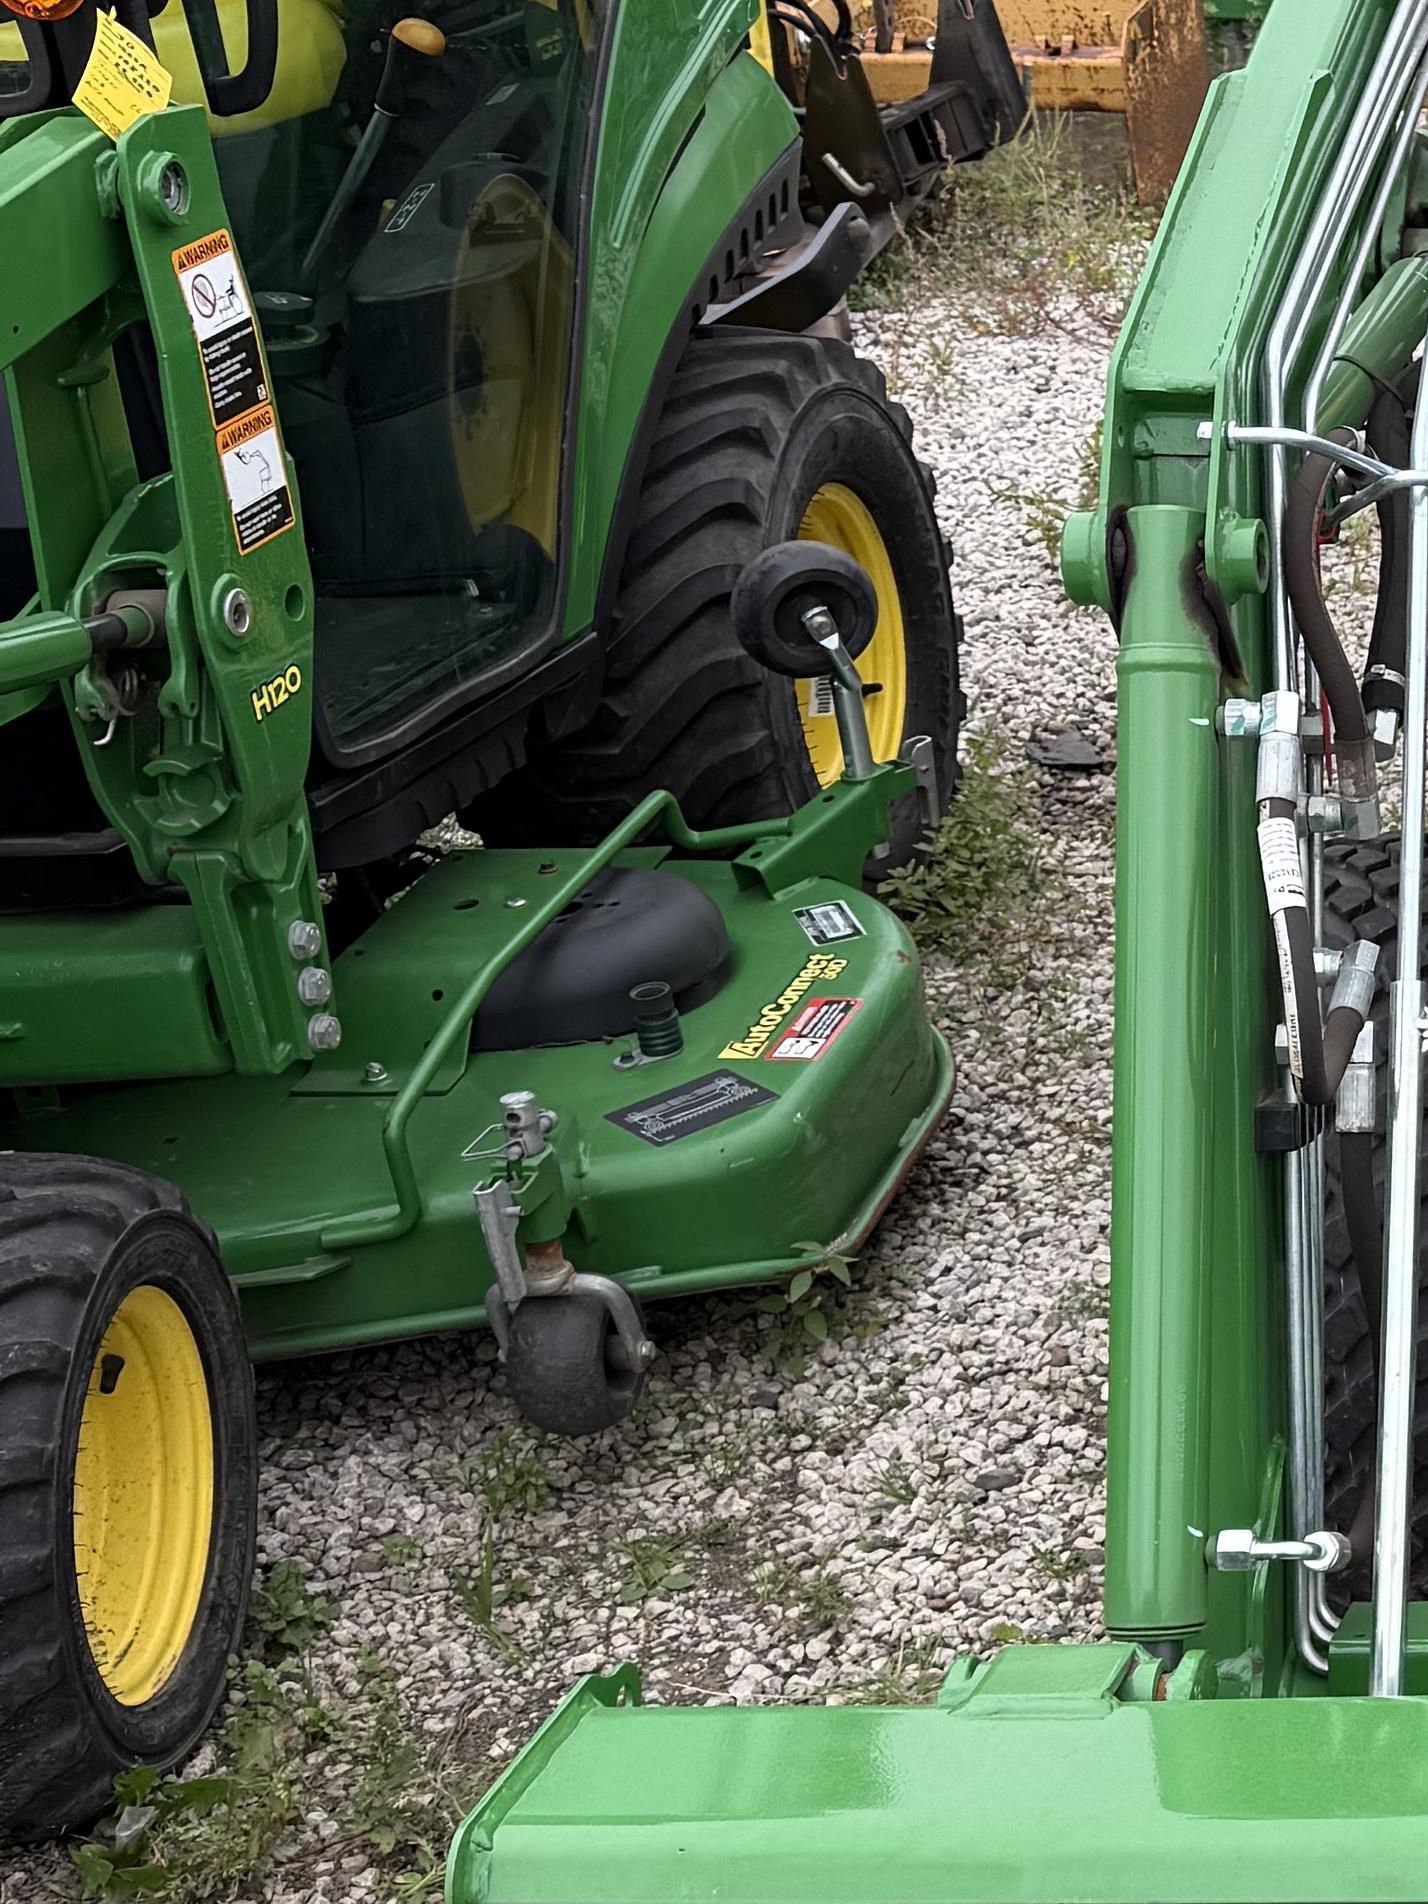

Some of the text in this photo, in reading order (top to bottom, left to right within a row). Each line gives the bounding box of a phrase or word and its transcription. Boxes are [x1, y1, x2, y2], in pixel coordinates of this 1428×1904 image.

[184, 235, 229, 265] WARNING
[228, 410, 273, 446] WARNING
[731, 953, 835, 1058] AutoConnect
